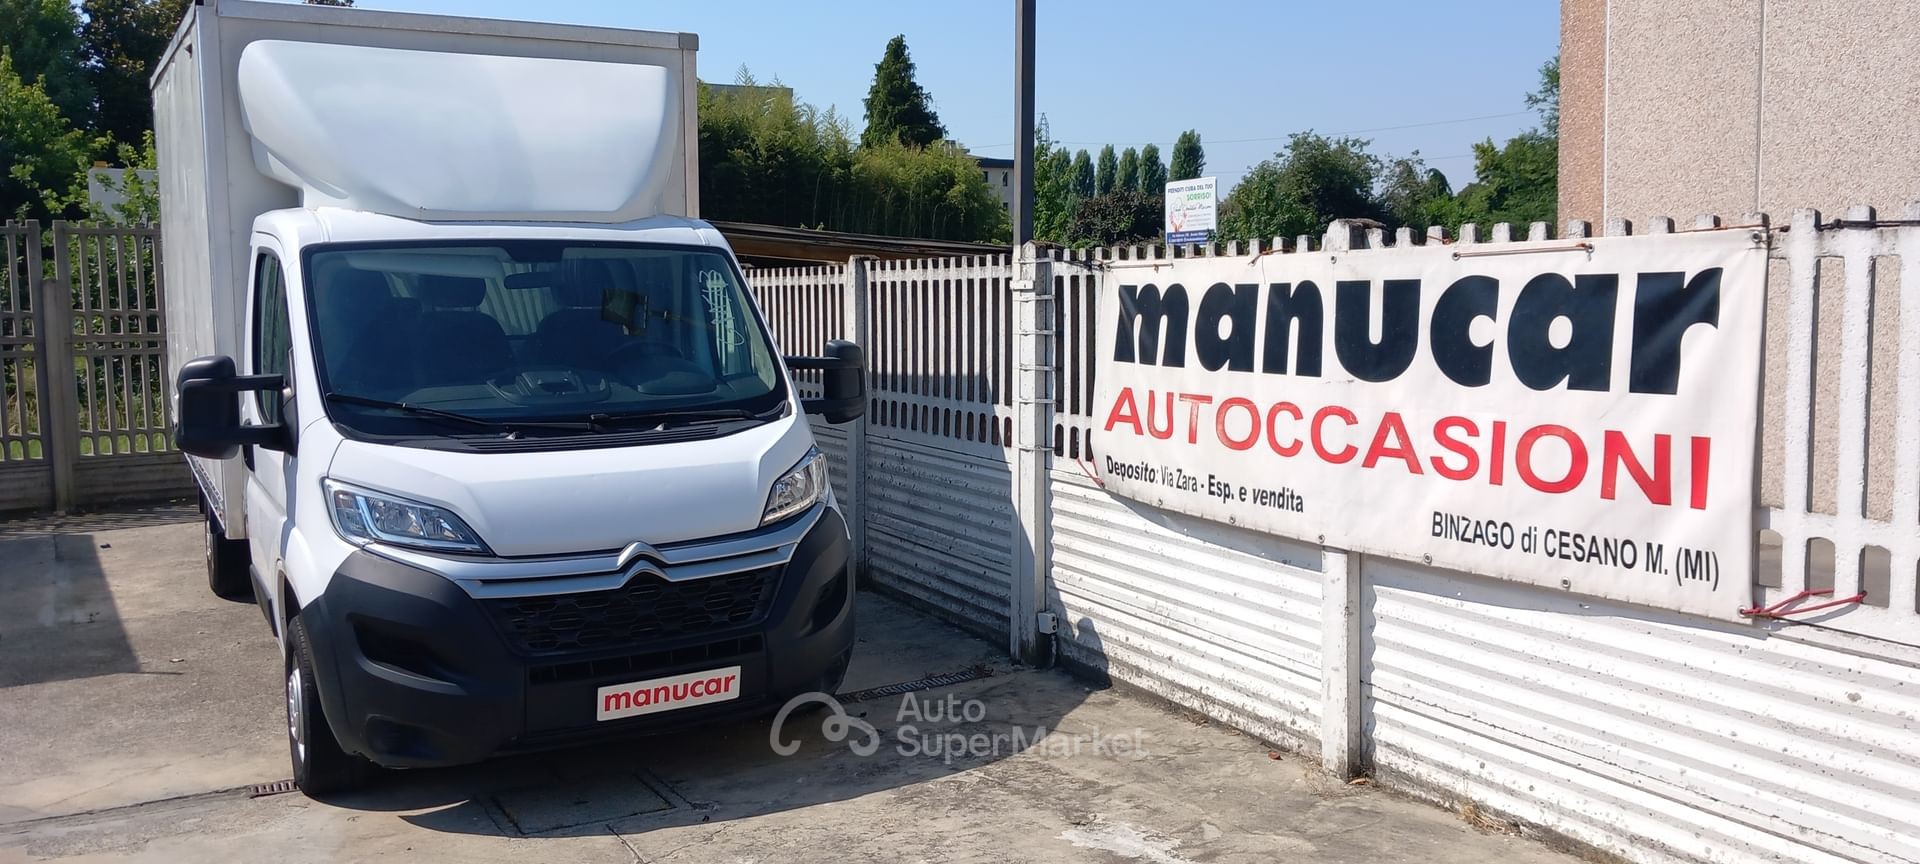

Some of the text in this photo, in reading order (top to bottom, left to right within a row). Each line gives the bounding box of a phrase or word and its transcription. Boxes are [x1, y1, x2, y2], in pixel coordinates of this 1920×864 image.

[1114, 266, 1723, 395] manucar
[1104, 387, 1711, 511] AUTOCCASIONI
[1106, 455, 1159, 484] Deposito:
[1161, 464, 1174, 488] Via
[1176, 469, 1198, 492] Zara
[1208, 474, 1235, 503] Esp.
[1239, 486, 1248, 502] e
[1252, 486, 1304, 513] vendita
[1431, 511, 1719, 591] BINZAGO di CESANO M. (MI)
[604, 672, 736, 712] manucar
